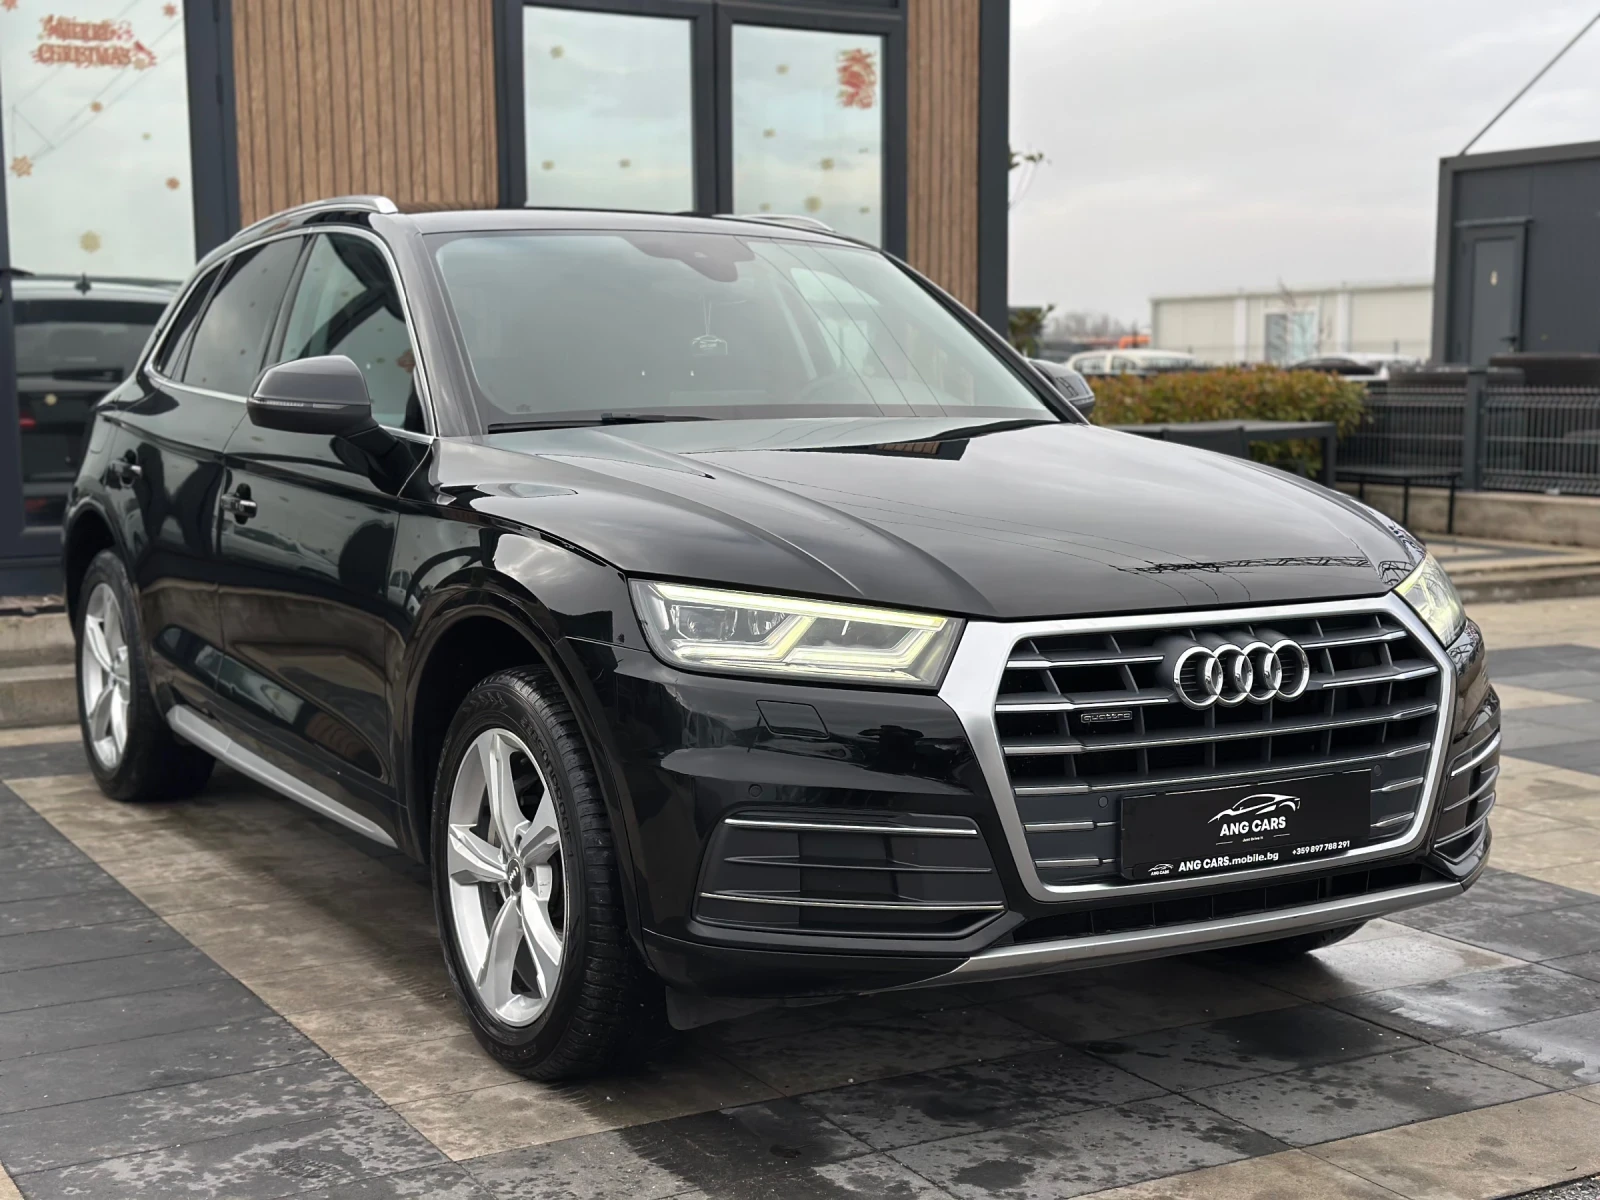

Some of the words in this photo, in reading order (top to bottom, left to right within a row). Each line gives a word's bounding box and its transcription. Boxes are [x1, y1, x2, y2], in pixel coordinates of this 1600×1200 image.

[37, 43, 132, 67] CHRISTMAS
[1082, 712, 1131, 722] quattro
[1219, 822, 1250, 837] ANG
[1251, 815, 1287, 833] CARS
[1292, 846, 1310, 855] +359
[1310, 844, 1324, 853] 897
[1323, 842, 1338, 851] 788
[1337, 840, 1351, 849] 291
[1178, 860, 1202, 872] ANG
[1202, 851, 1279, 869] CARS.mobile.bg
